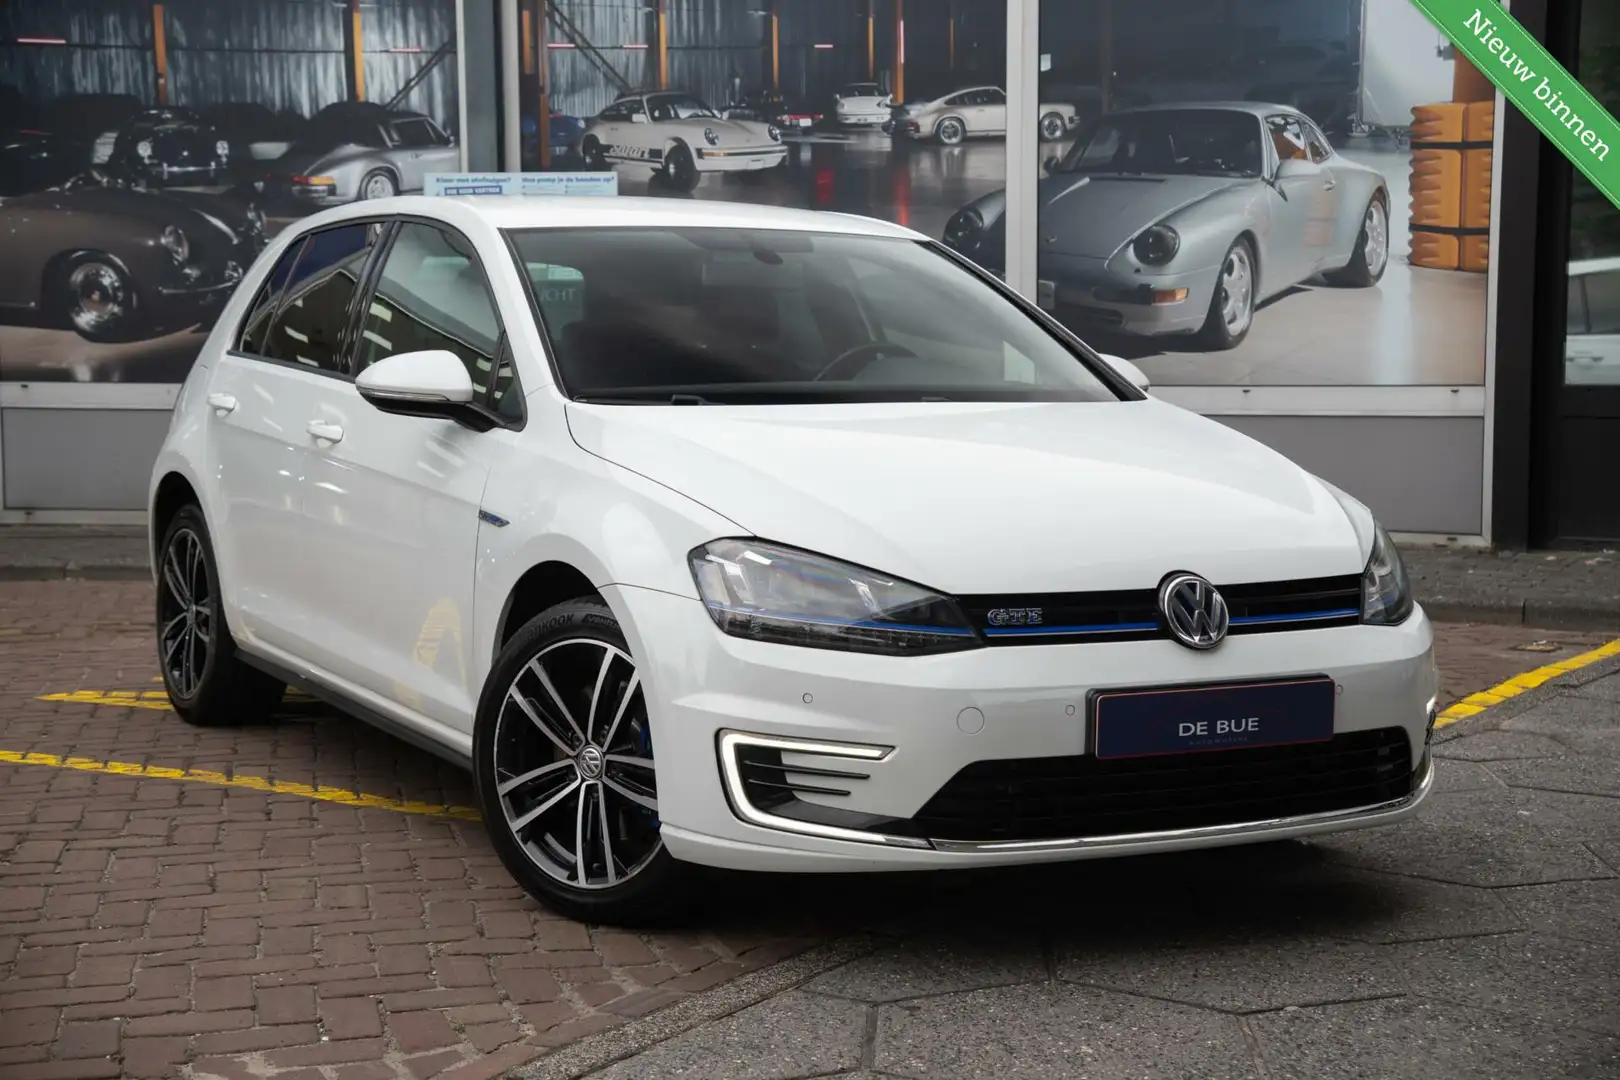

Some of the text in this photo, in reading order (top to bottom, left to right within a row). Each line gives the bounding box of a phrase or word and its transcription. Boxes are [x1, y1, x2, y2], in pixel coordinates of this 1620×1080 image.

[987, 607, 1043, 626] GTE
[1178, 717, 1260, 737] DE BUE
